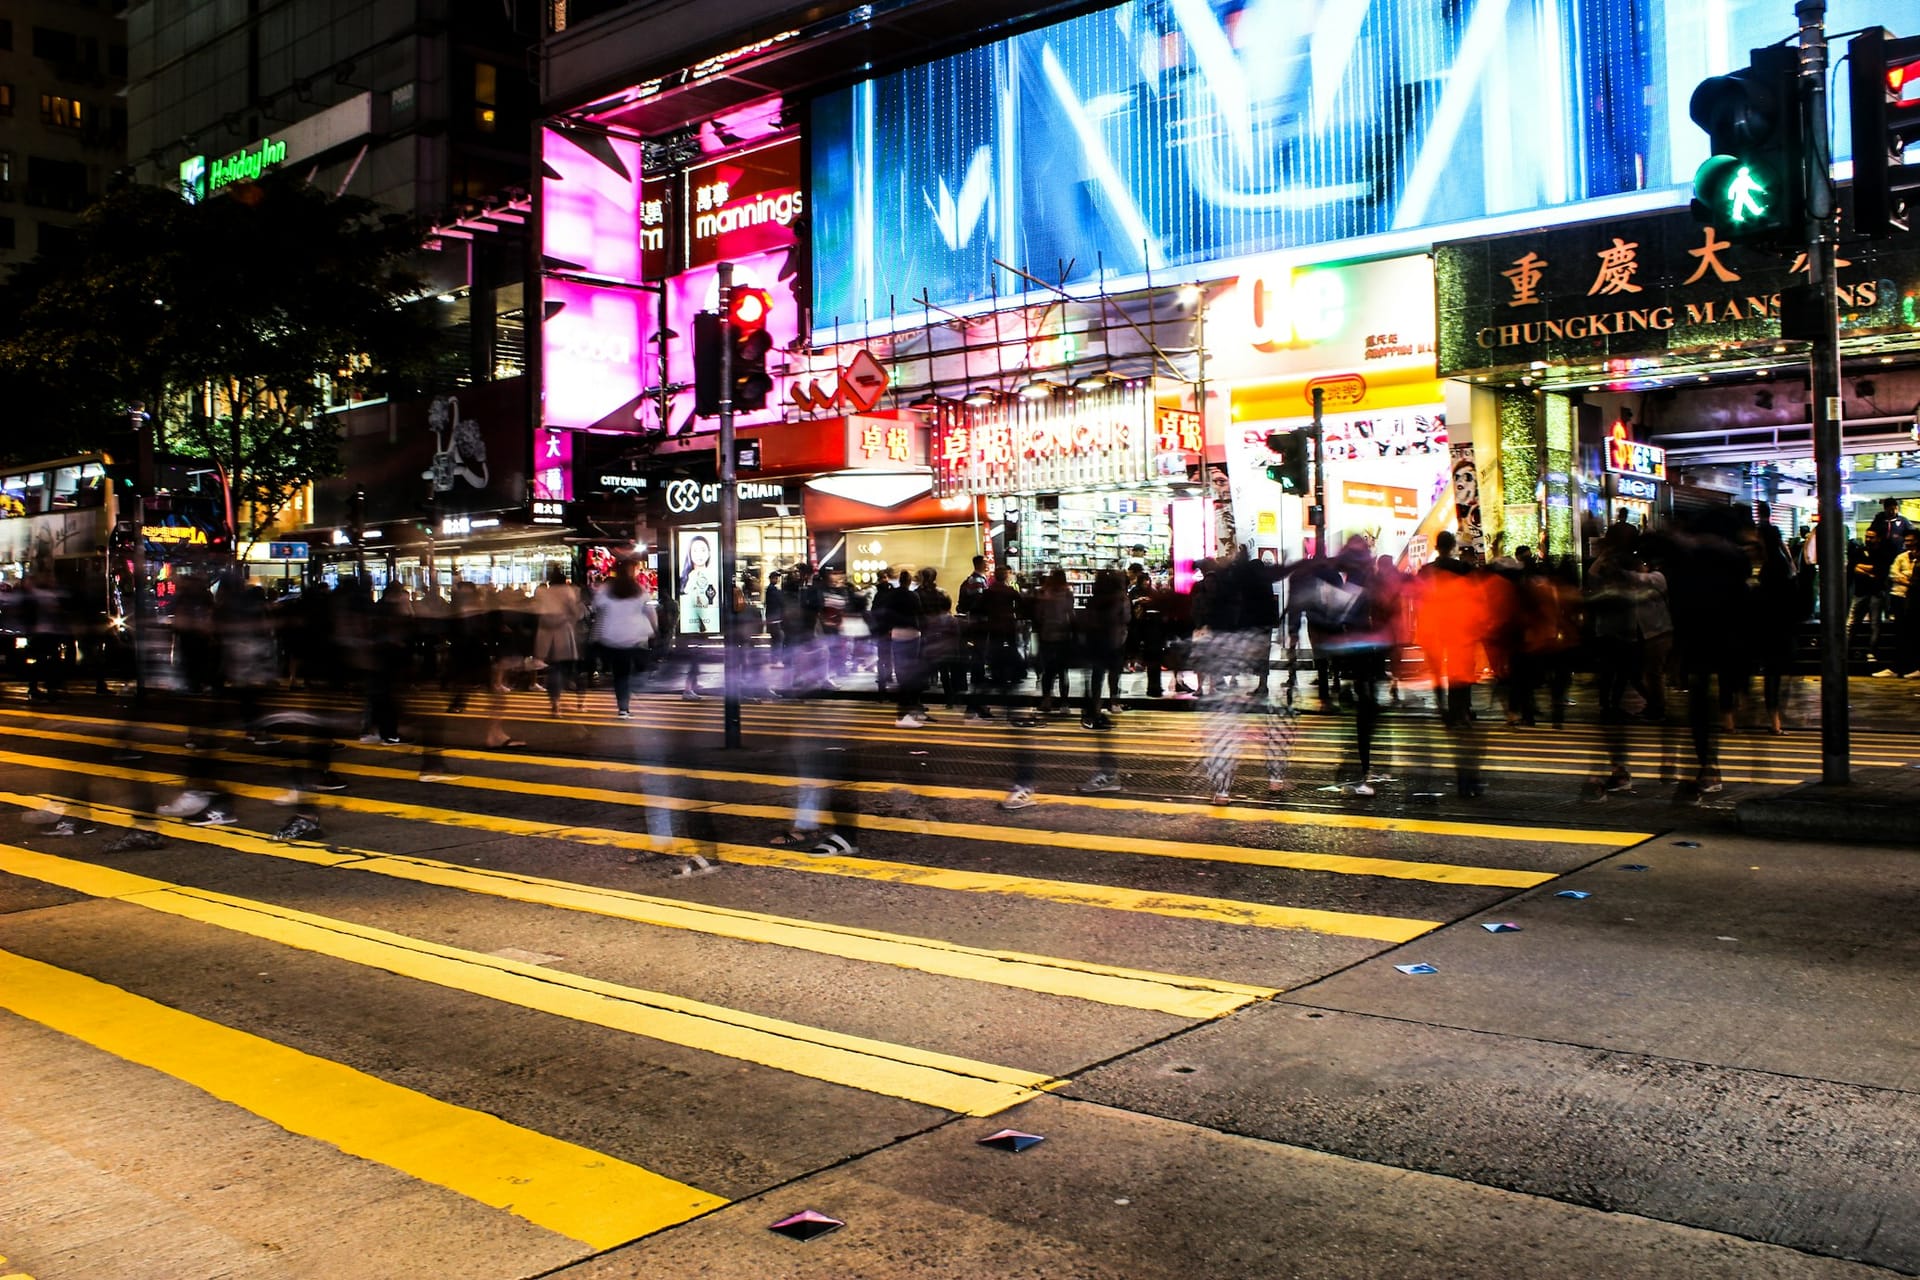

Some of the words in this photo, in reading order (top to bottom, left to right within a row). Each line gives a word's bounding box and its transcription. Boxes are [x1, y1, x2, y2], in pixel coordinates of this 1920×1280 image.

[209, 149, 262, 190] Holiday
[262, 137, 286, 168] Inn
[696, 190, 803, 239] mannings
[1477, 305, 1675, 350] CHUNGKING
[1685, 279, 1878, 327] MANSNS
[600, 475, 620, 486] CITY
[620, 476, 647, 488] CHAIN
